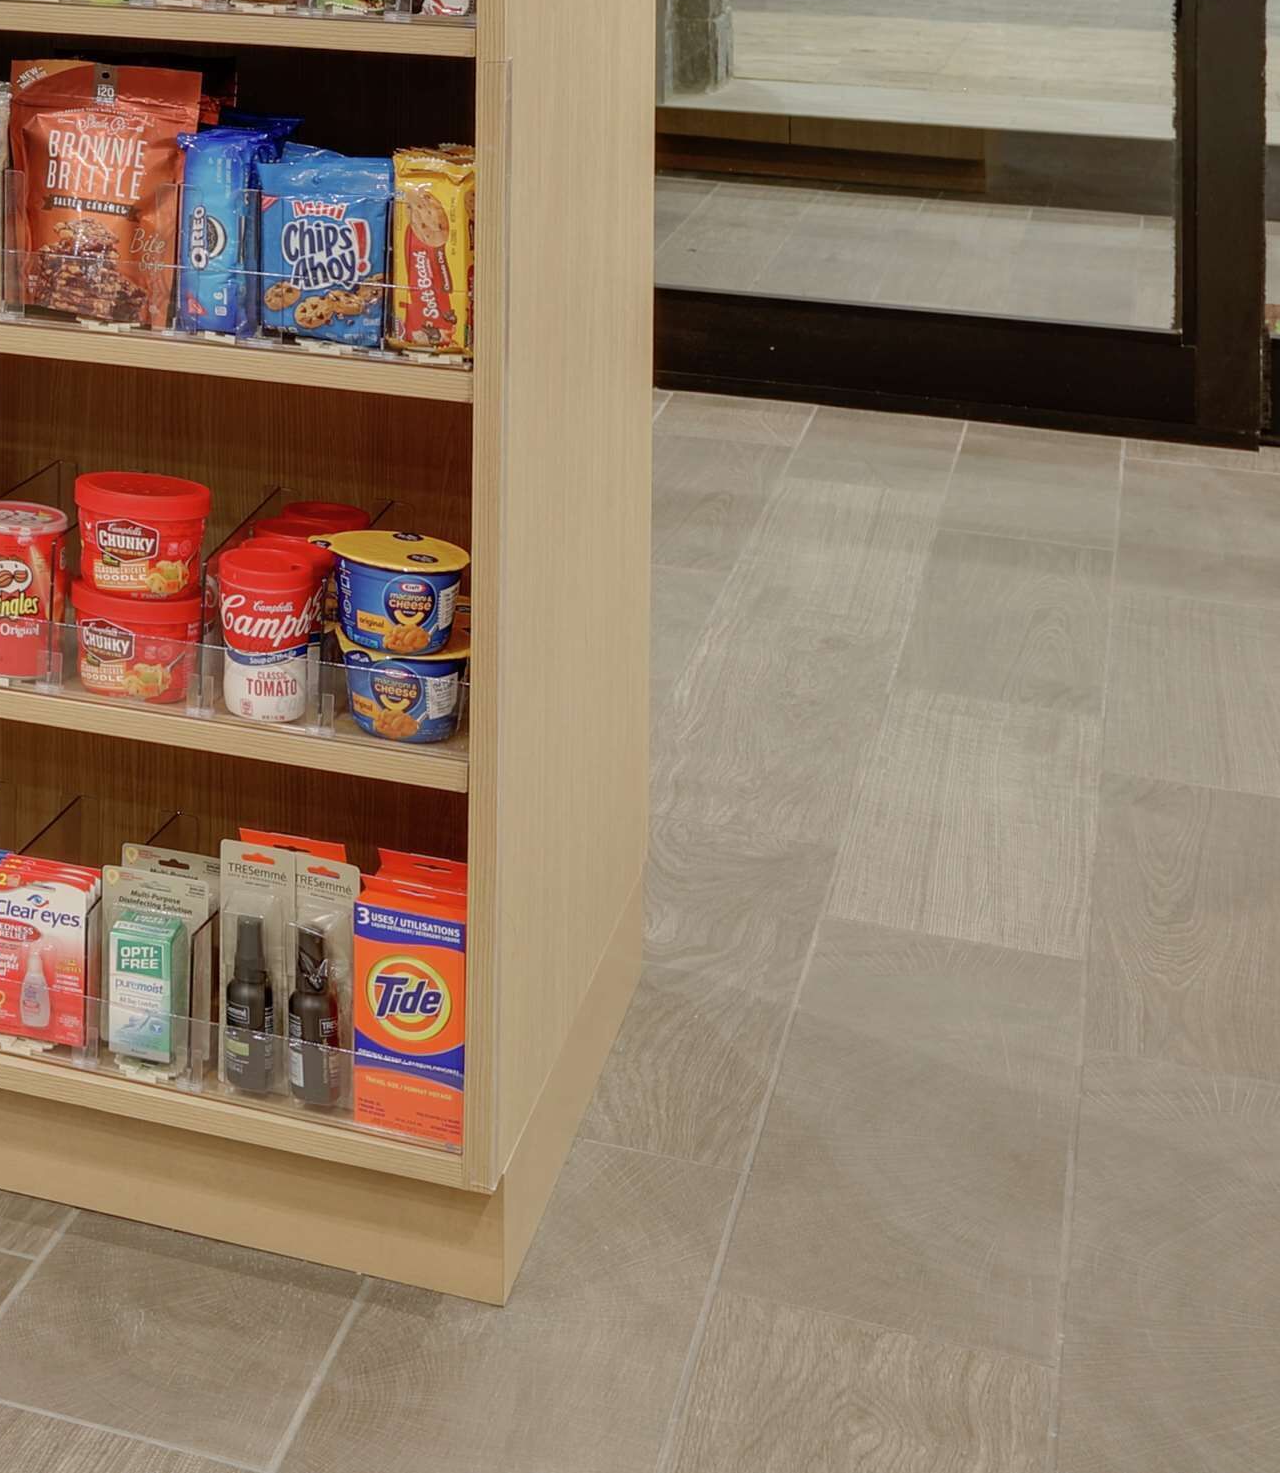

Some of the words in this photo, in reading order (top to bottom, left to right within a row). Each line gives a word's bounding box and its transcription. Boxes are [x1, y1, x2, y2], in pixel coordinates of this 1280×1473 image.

[97, 85, 115, 97] 120
[49, 130, 148, 169] BROWNIE
[46, 160, 147, 200] BRITTLE
[293, 201, 348, 220] Mini
[191, 206, 208, 270] OREO
[282, 219, 353, 262] Chips
[415, 250, 433, 289] Batch
[422, 290, 438, 320] Soft
[98, 529, 155, 553] CHUNKY
[95, 573, 148, 582] NOODLE
[82, 626, 130, 655] CHUNKY
[257, 671, 287, 680] CLASSIC
[246, 678, 298, 697] TOMATO
[229, 862, 287, 882] TRESemmé
[295, 873, 353, 895] TRESemmé
[131, 889, 181, 904] Multi-Purpose
[41, 910, 80, 928] eyes
[357, 907, 370, 924] 3
[371, 912, 399, 928] USES/
[400, 918, 461, 938] UTILISATIONS
[0, 930, 27, 940] RELIEF
[121, 946, 159, 958] OPTI-
[121, 958, 159, 969] FREE
[115, 977, 163, 995] puremoist
[374, 975, 443, 1019] Tide
